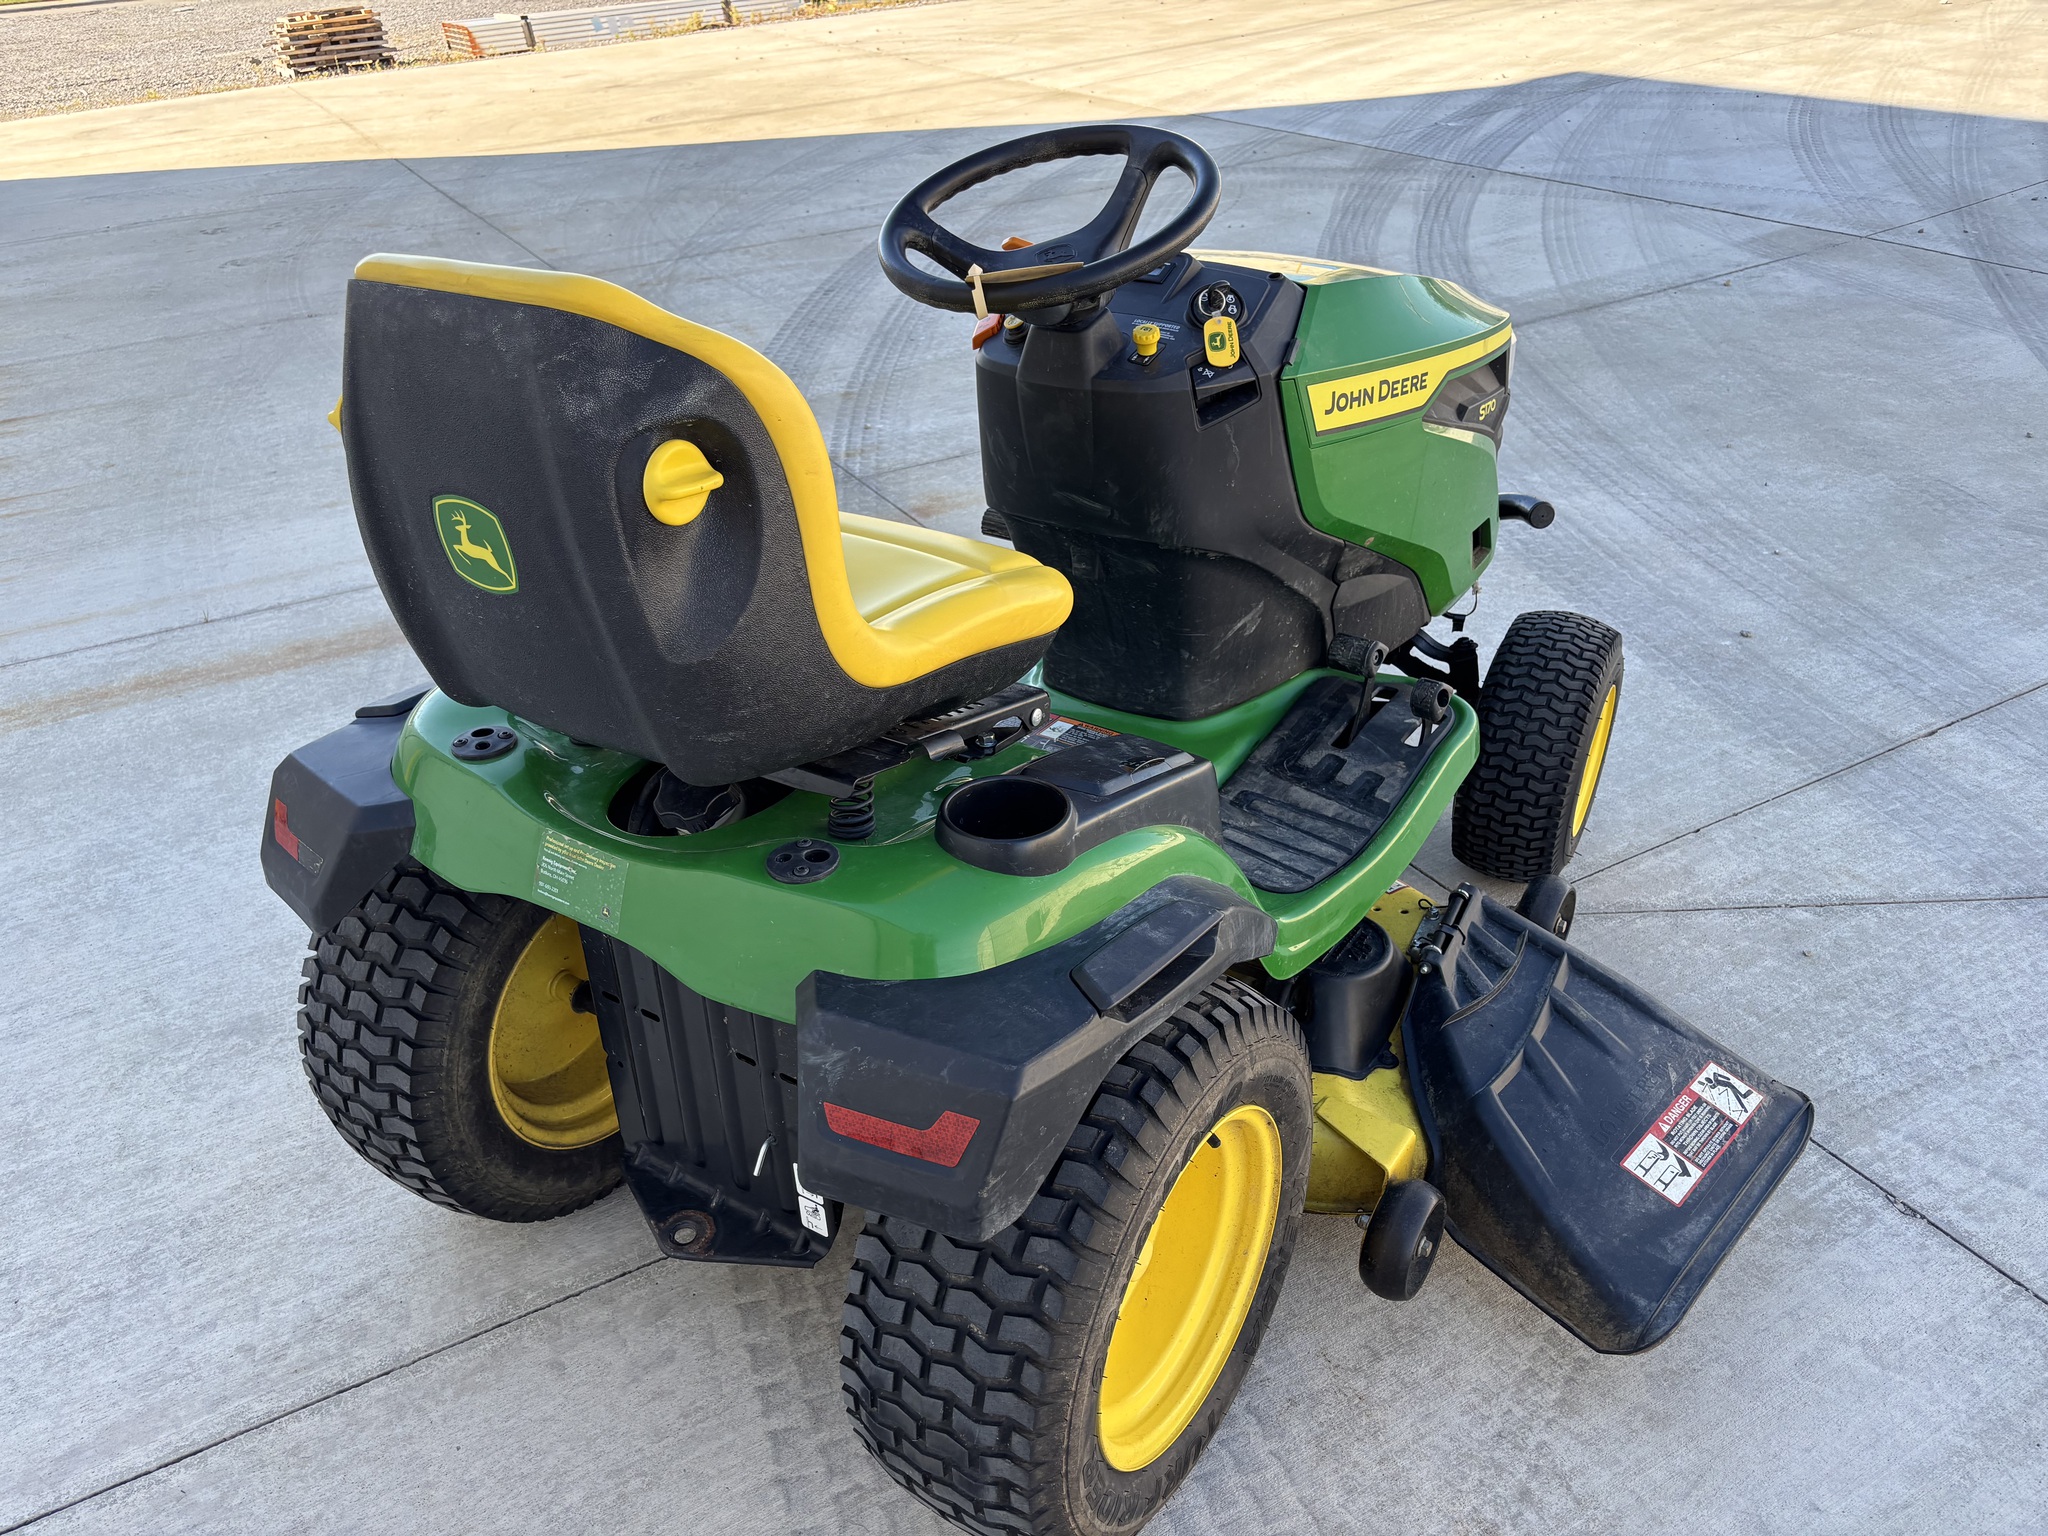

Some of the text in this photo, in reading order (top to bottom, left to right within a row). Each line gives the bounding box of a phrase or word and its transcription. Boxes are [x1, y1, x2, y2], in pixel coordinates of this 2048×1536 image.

[1324, 371, 1429, 416] JOHN DEERE
[1084, 723, 1115, 736] WARNING
[1663, 1095, 1693, 1125] DANGER
[1670, 1104, 1697, 1135] ROTATING BLADE
[1682, 1112, 1711, 1146] THROWN OBJECTS
[1080, 1407, 1221, 1527] TURF RIDER
